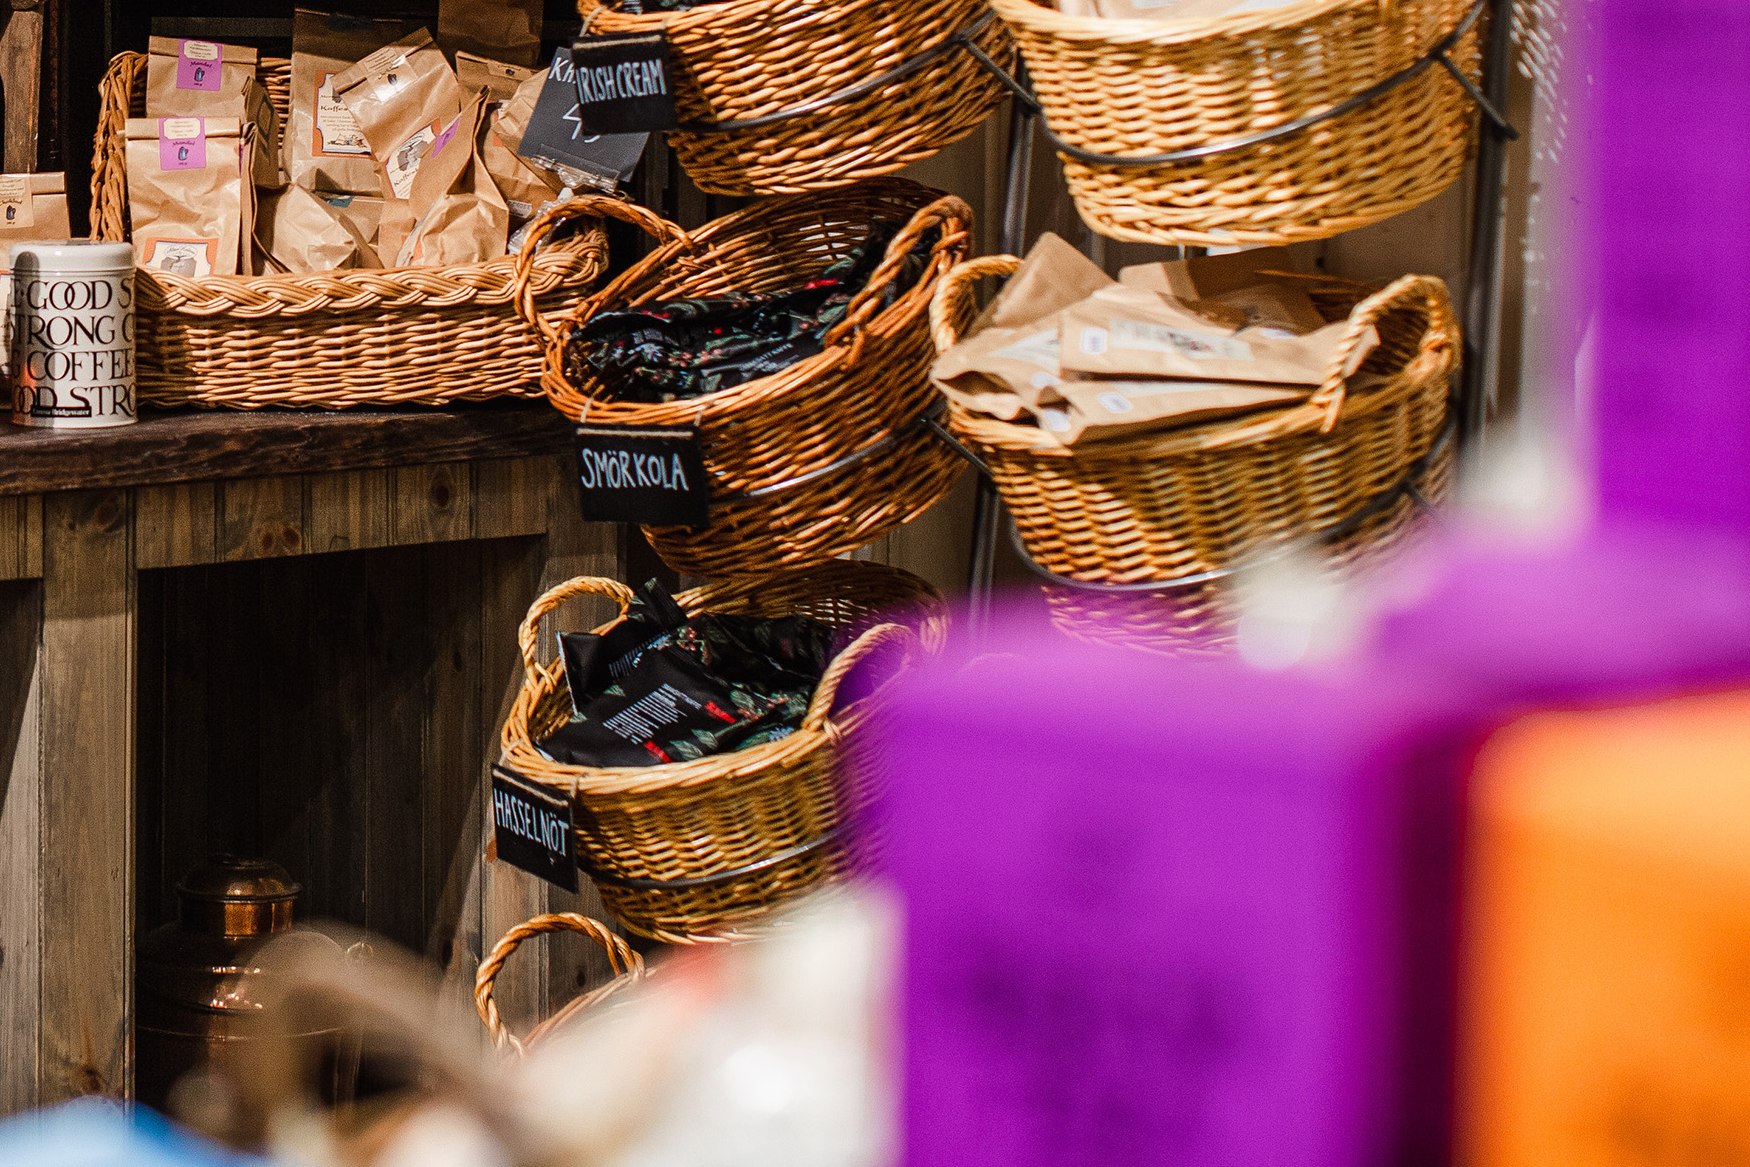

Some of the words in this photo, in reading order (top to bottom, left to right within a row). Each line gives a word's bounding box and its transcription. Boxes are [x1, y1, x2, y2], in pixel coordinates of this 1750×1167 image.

[575, 65, 617, 105] IRISH
[616, 57, 668, 99] CREAM
[26, 279, 113, 311] GOOD
[26, 348, 134, 382] COFFEE
[51, 408, 90, 417] Bridgewater
[580, 446, 690, 493] SMÖRKOLA
[493, 787, 570, 858] HASSELNÖT
